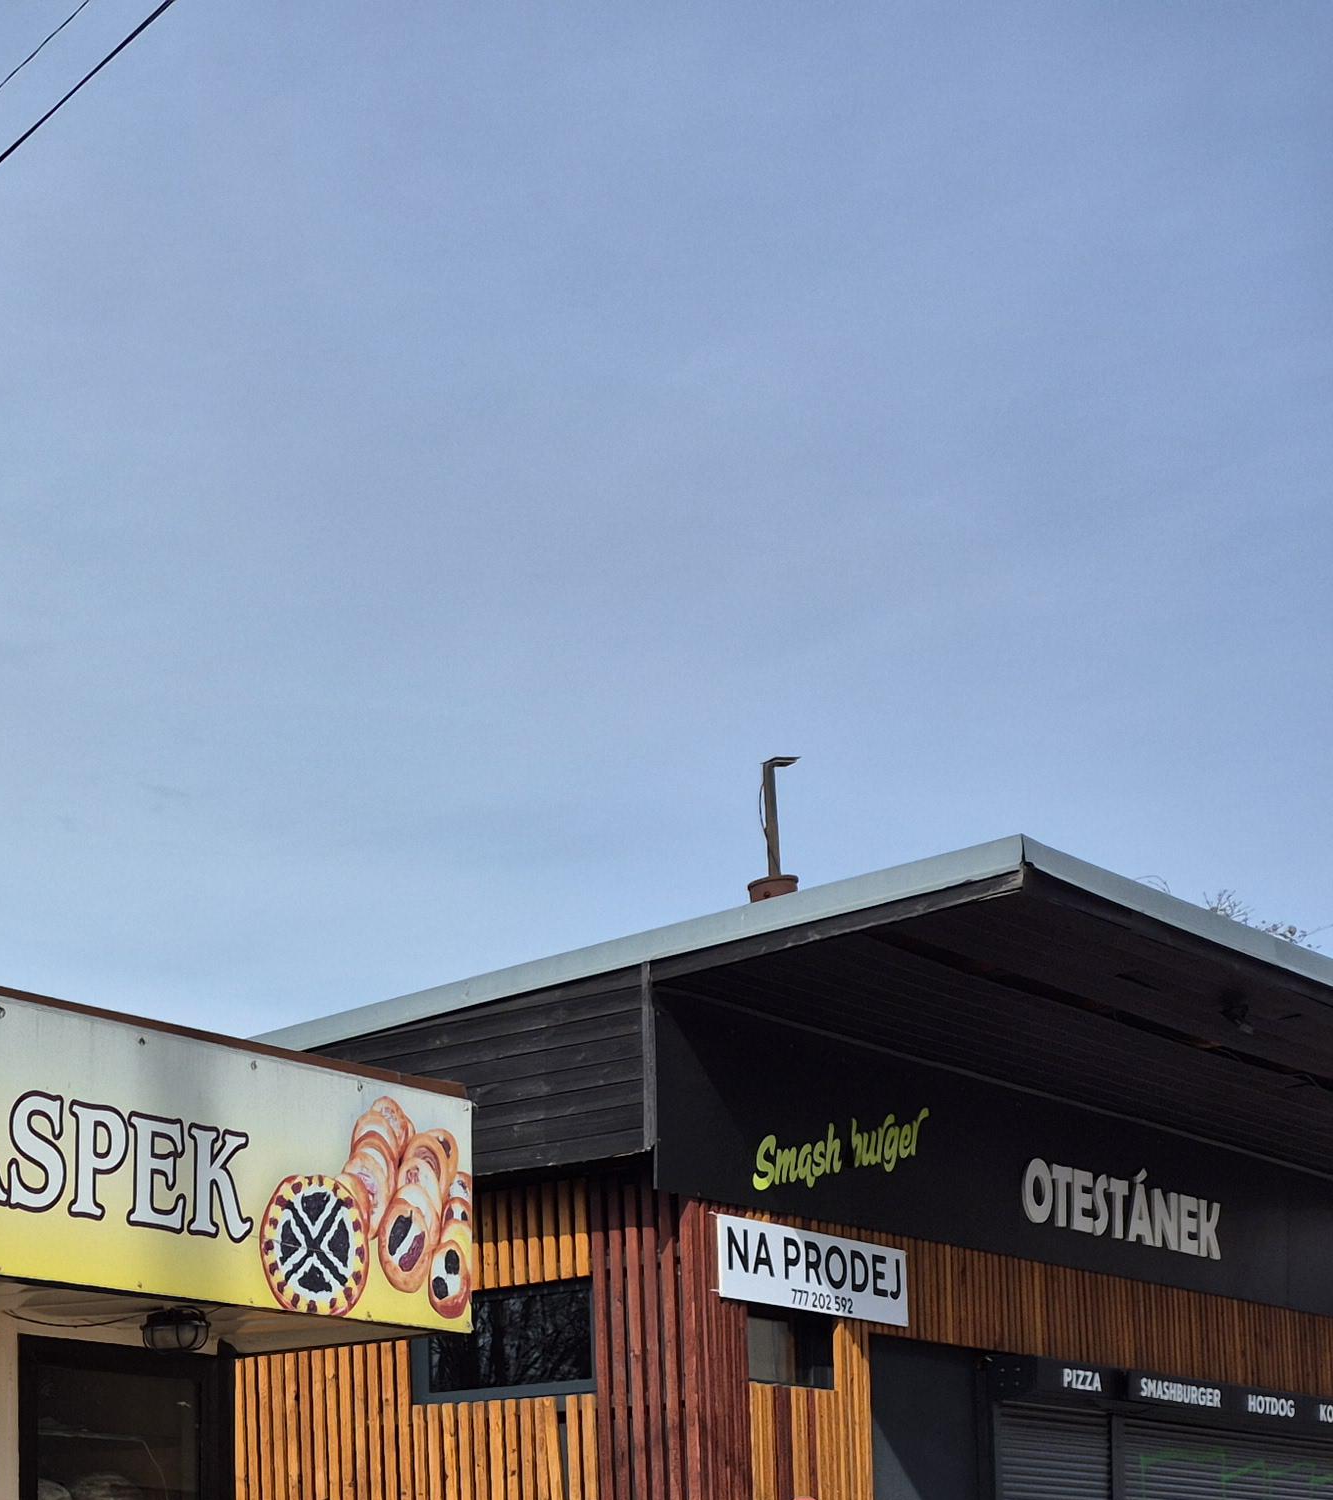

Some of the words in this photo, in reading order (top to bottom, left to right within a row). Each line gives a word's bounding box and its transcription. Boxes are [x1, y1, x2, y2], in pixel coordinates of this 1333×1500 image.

[752, 1122, 843, 1191] Smash
[1021, 1157, 1222, 1260] OTESTÁNEK
[726, 1226, 776, 1278] NA
[783, 1236, 902, 1301] PRODEJ
[791, 1288, 810, 1308] 777
[812, 1291, 833, 1312] 202
[834, 1295, 854, 1315] 592
[1062, 1367, 1102, 1392] PIZZA
[1140, 1377, 1222, 1408] SMASHBURGER
[1247, 1394, 1296, 1418] HOTDOG
